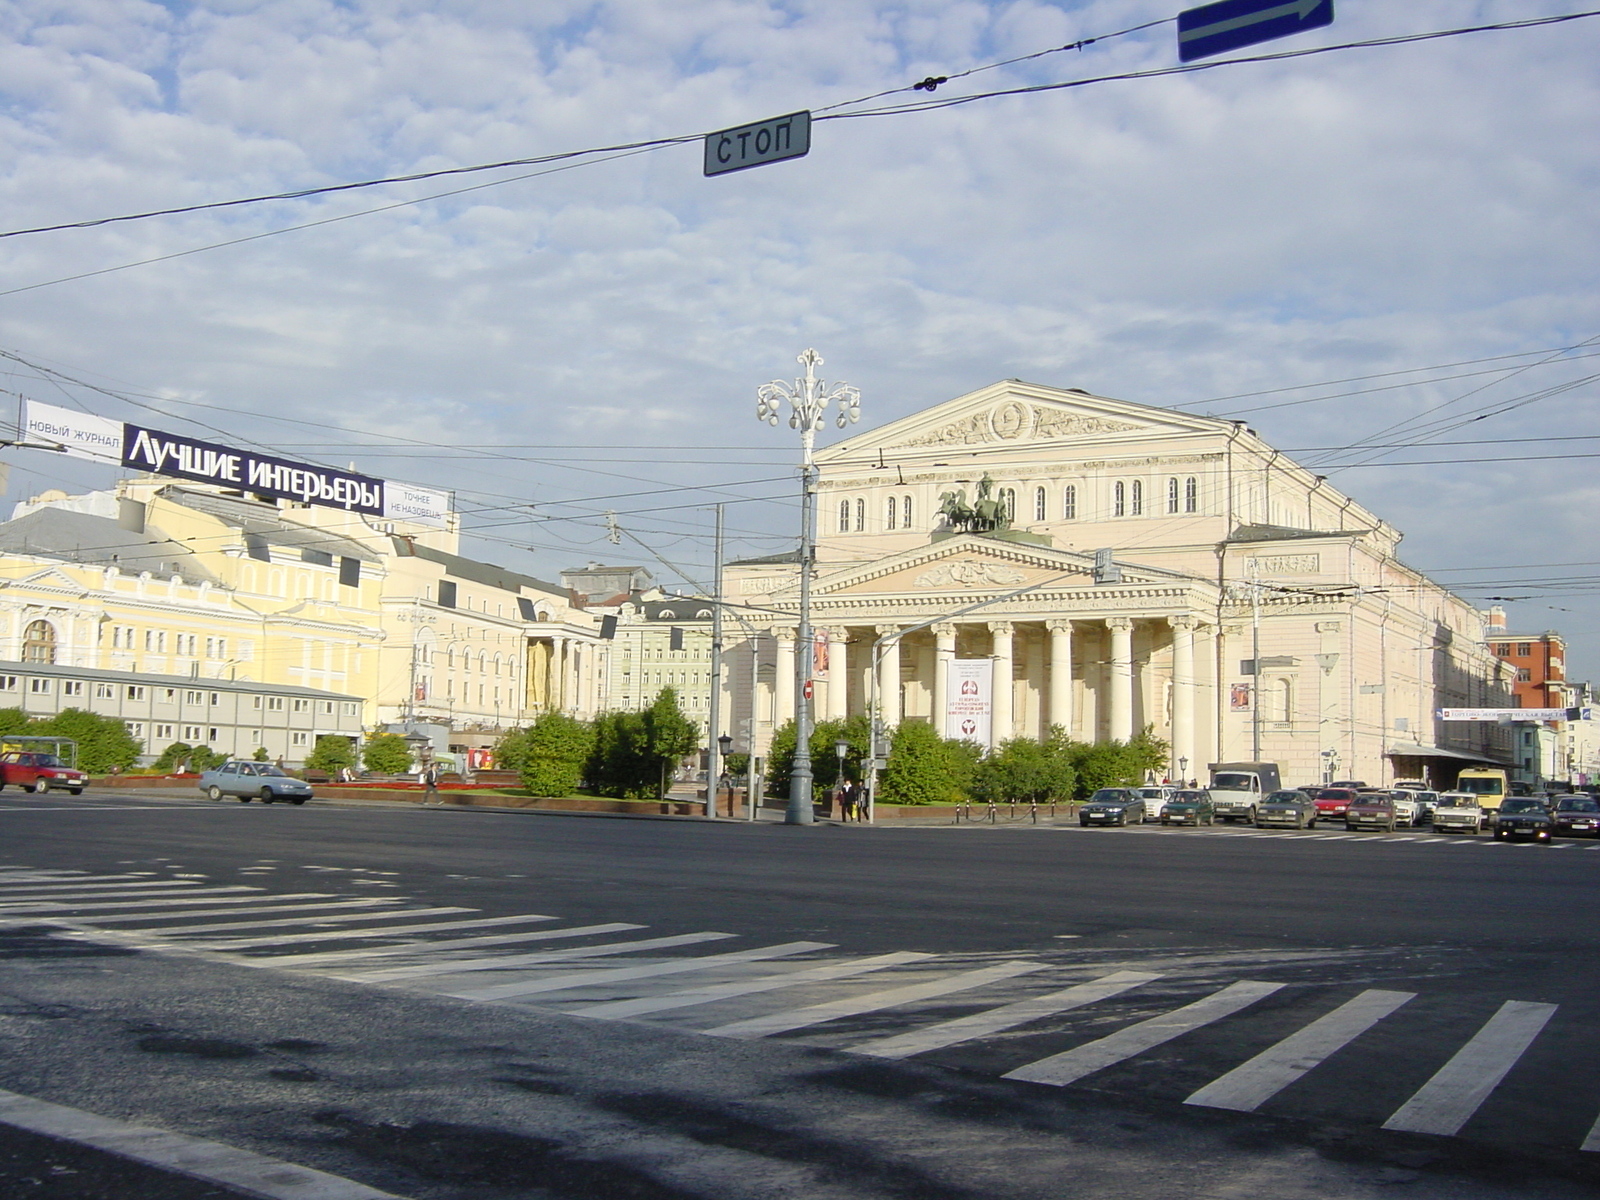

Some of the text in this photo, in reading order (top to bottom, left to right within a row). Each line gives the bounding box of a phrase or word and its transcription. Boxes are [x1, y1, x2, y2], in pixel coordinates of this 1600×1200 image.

[717, 122, 791, 164] СТОП
[29, 420, 120, 448] НОВЫЙ ЖУРНАЛ
[404, 491, 431, 505] ТОЧНЕЕ
[391, 502, 442, 520] НЕ НАЗОВЕШЬ
